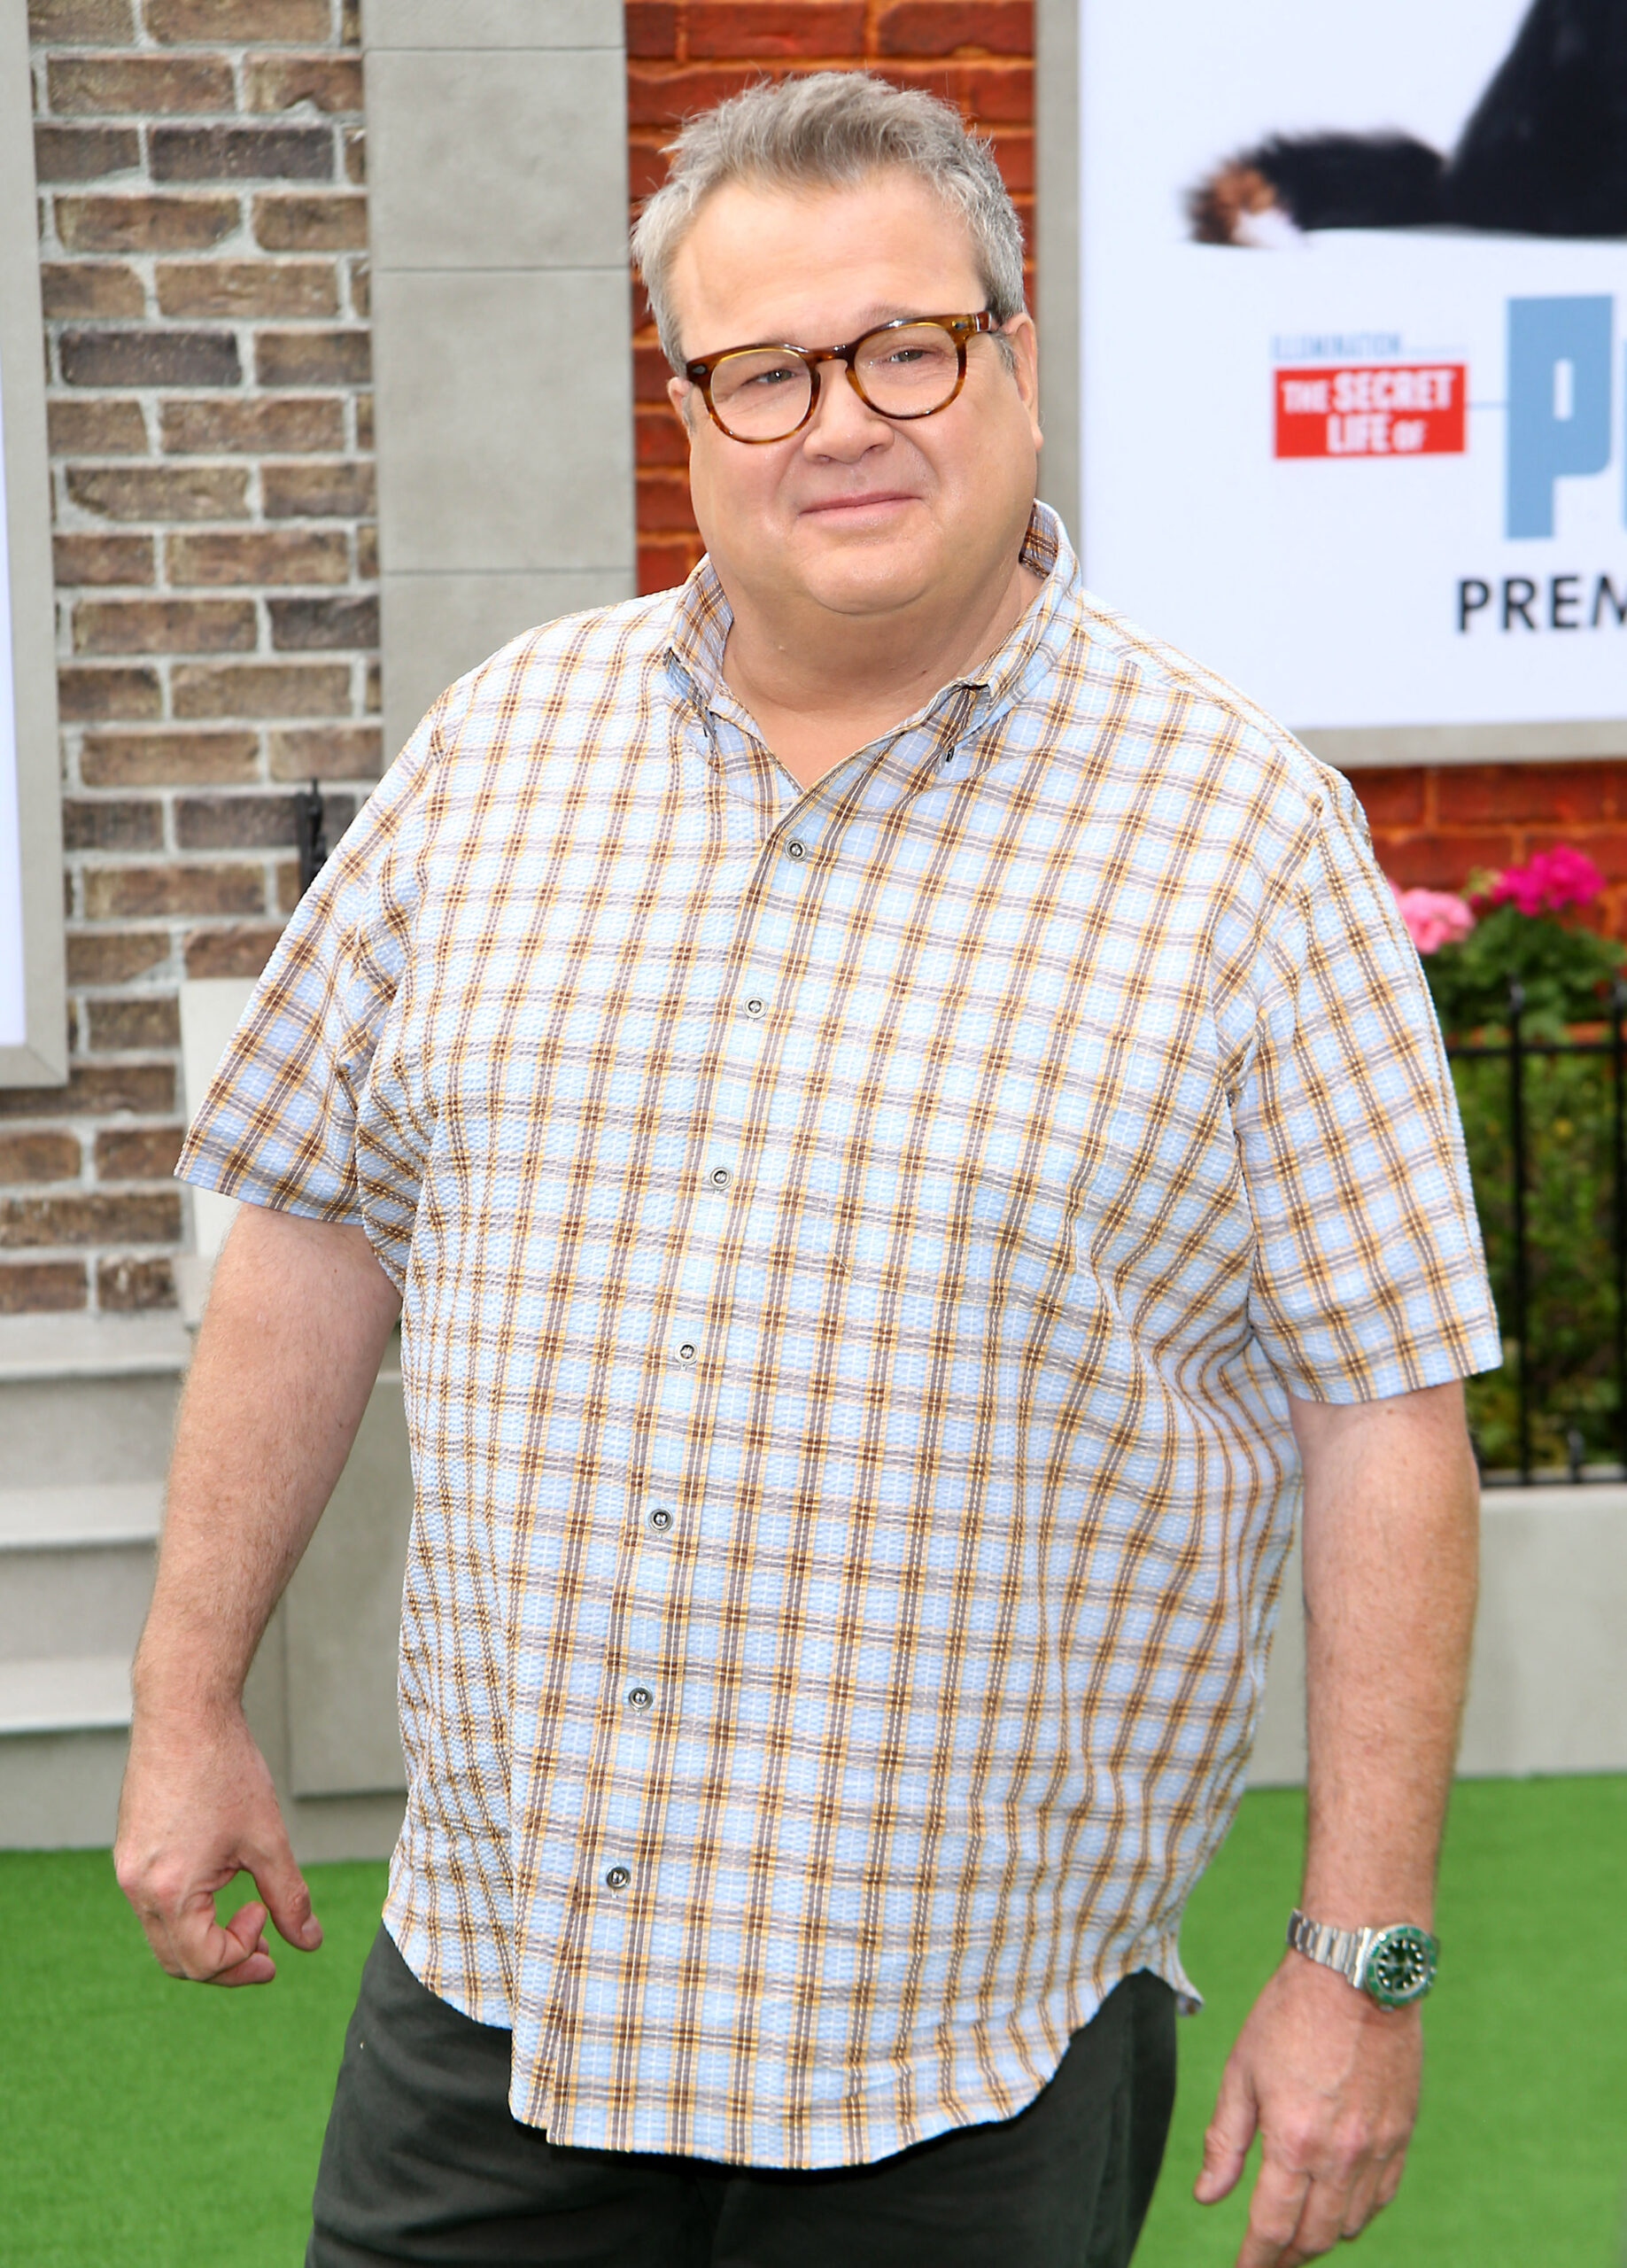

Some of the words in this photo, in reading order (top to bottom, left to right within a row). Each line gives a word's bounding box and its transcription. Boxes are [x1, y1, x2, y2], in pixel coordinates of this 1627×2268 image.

[1282, 379, 1329, 413] THE
[1332, 368, 1455, 412] SECRET
[1327, 413, 1391, 454] LIFE
[1505, 295, 1627, 540] P
